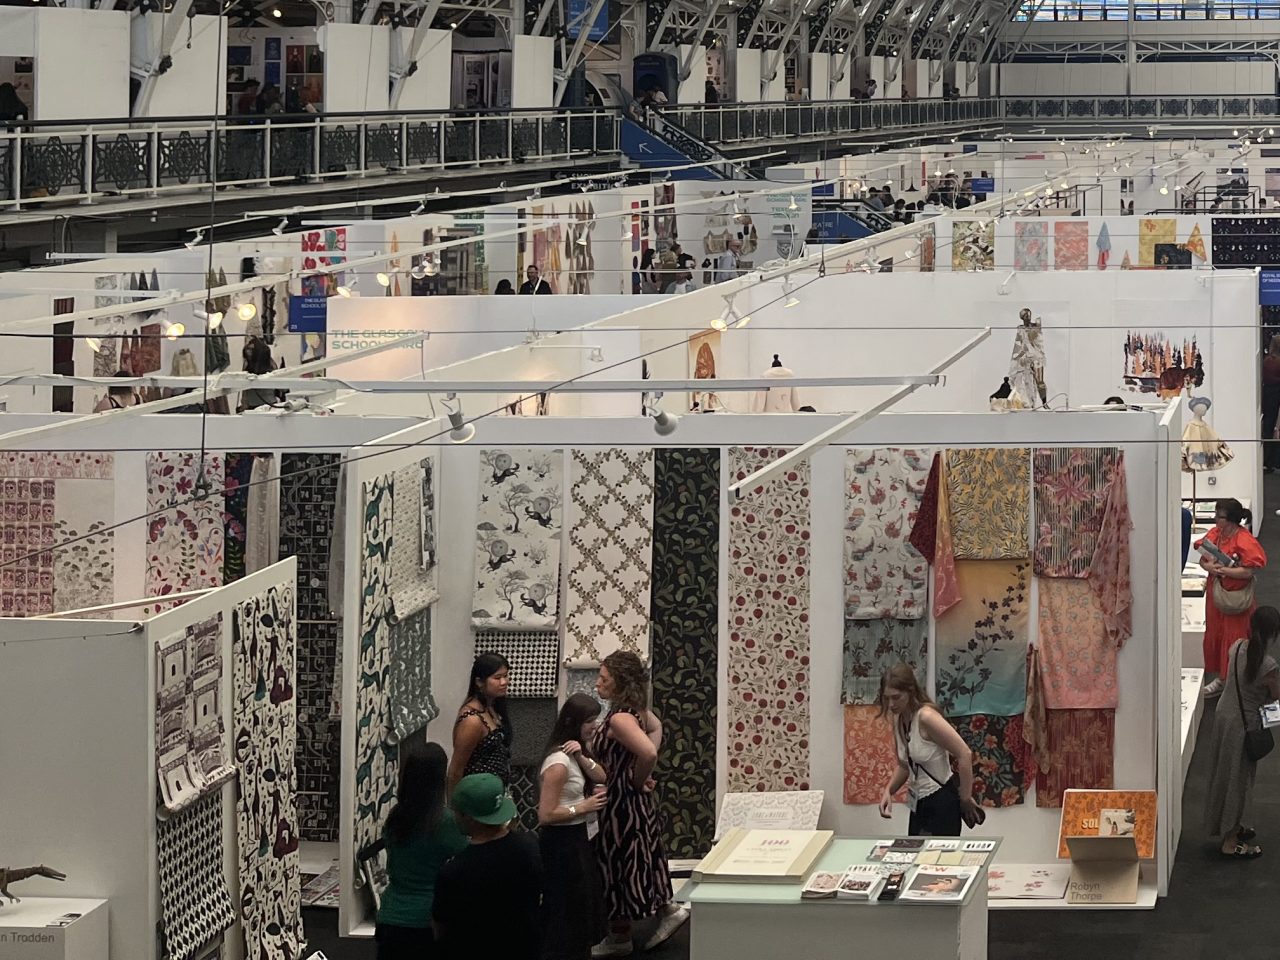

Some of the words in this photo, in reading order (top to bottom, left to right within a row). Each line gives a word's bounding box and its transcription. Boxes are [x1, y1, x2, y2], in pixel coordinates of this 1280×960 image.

[332, 330, 357, 338] THE
[1070, 882, 1100, 890] Robyn
[1071, 891, 1102, 901] Thorpe
[10, 932, 55, 942] Trodden
